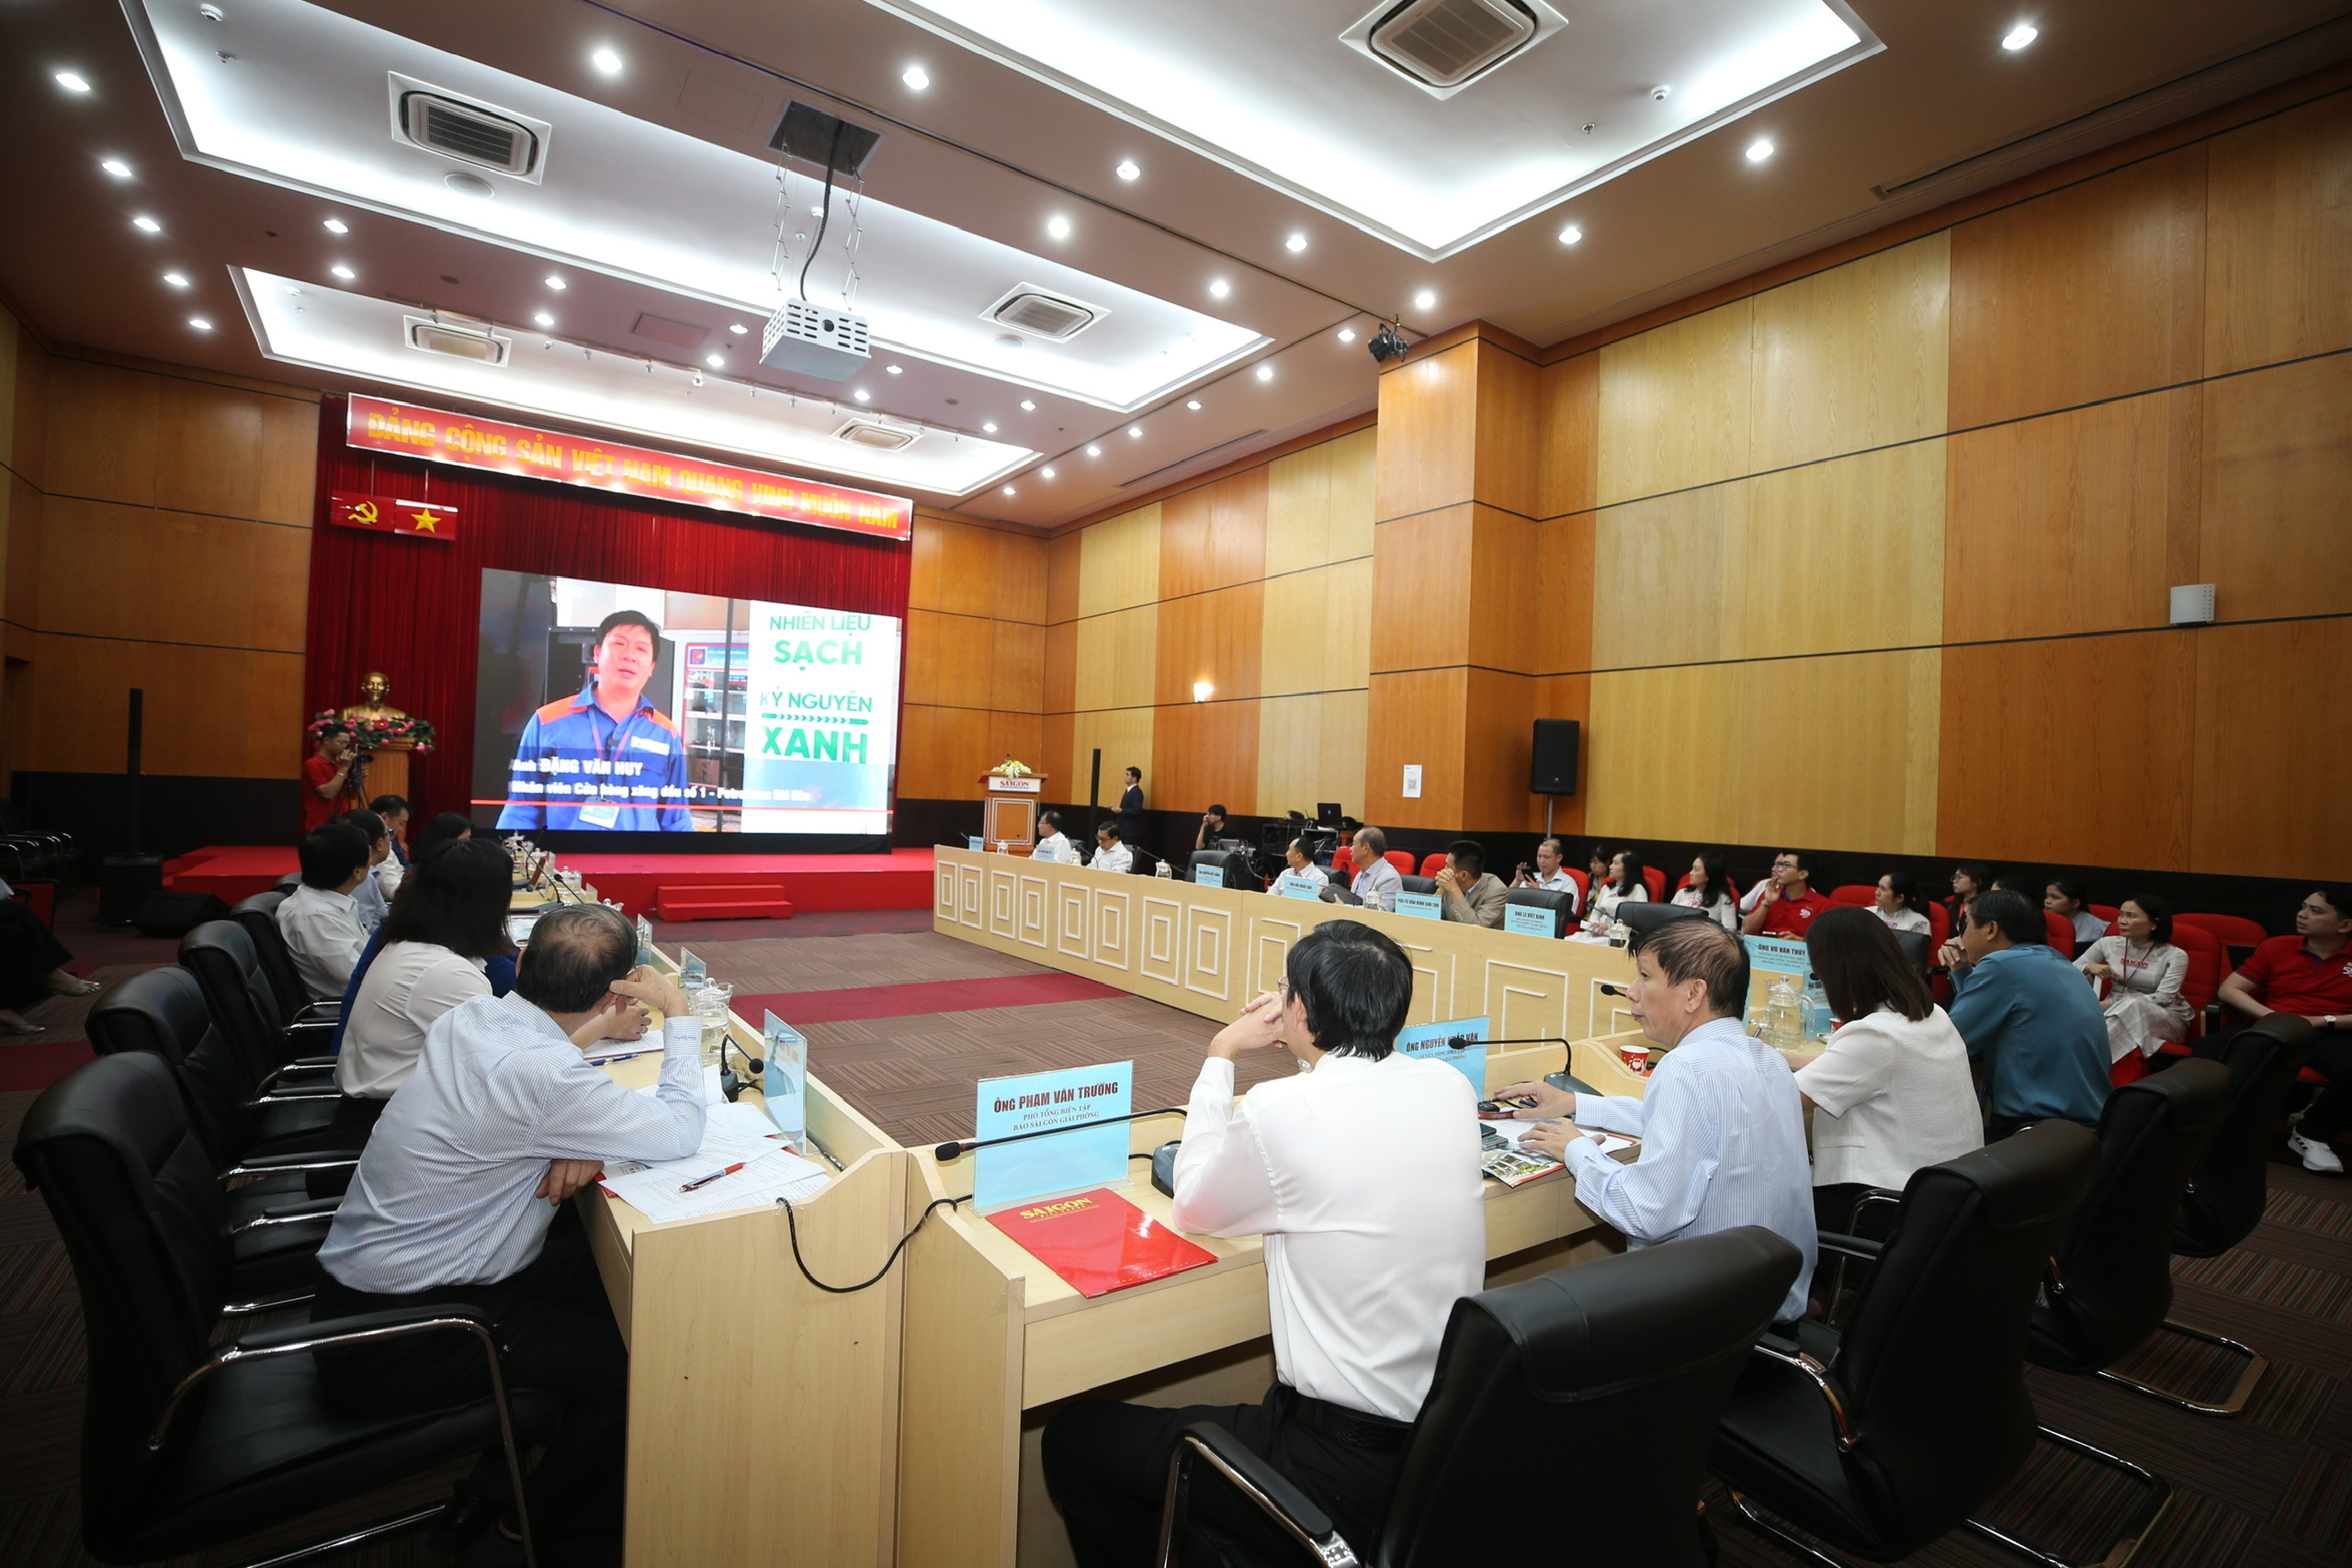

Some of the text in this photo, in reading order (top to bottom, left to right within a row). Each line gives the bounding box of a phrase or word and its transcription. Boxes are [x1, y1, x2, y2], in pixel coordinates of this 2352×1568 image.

[367, 407, 898, 529] ĐẢNG CỘNG SẢN VIỆT NAM QUANG VINH MUÔN NĂM
[770, 610, 872, 637] NHIÊN LIỆU
[774, 639, 863, 671] SẠCH
[788, 690, 873, 713] NGUYÊN
[761, 726, 868, 764] XANH
[509, 756, 643, 776] Anh ĐẶNG VĂN HUY
[1406, 1041, 1419, 1052] ÔNG
[994, 1081, 1118, 1113] ÔNG PHẠM VĂN TRƯỜNG
[1013, 1111, 1100, 1131] BÁO SÀI GÒN GIẢI PHÓNG
[1023, 1102, 1091, 1121] PHÓ TỔNG BIÊN TẬP
[1019, 1197, 1093, 1220] SAIGON
